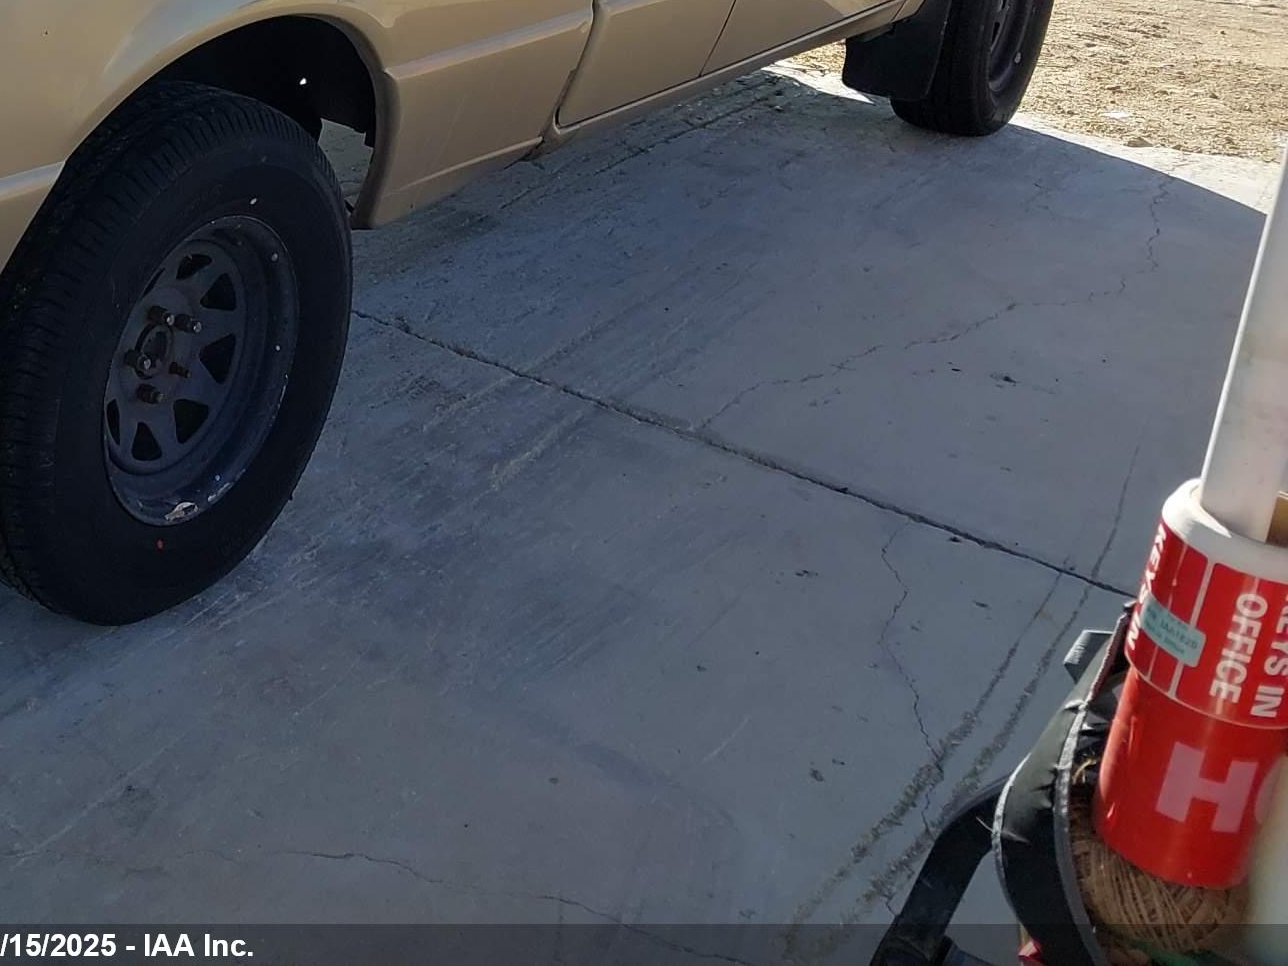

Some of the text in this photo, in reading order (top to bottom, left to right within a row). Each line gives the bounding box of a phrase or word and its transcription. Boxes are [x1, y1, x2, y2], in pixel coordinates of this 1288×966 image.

[1209, 593, 1269, 704] OFFICE
[1250, 684, 1286, 718] IN
[1155, 740, 1288, 834] H
